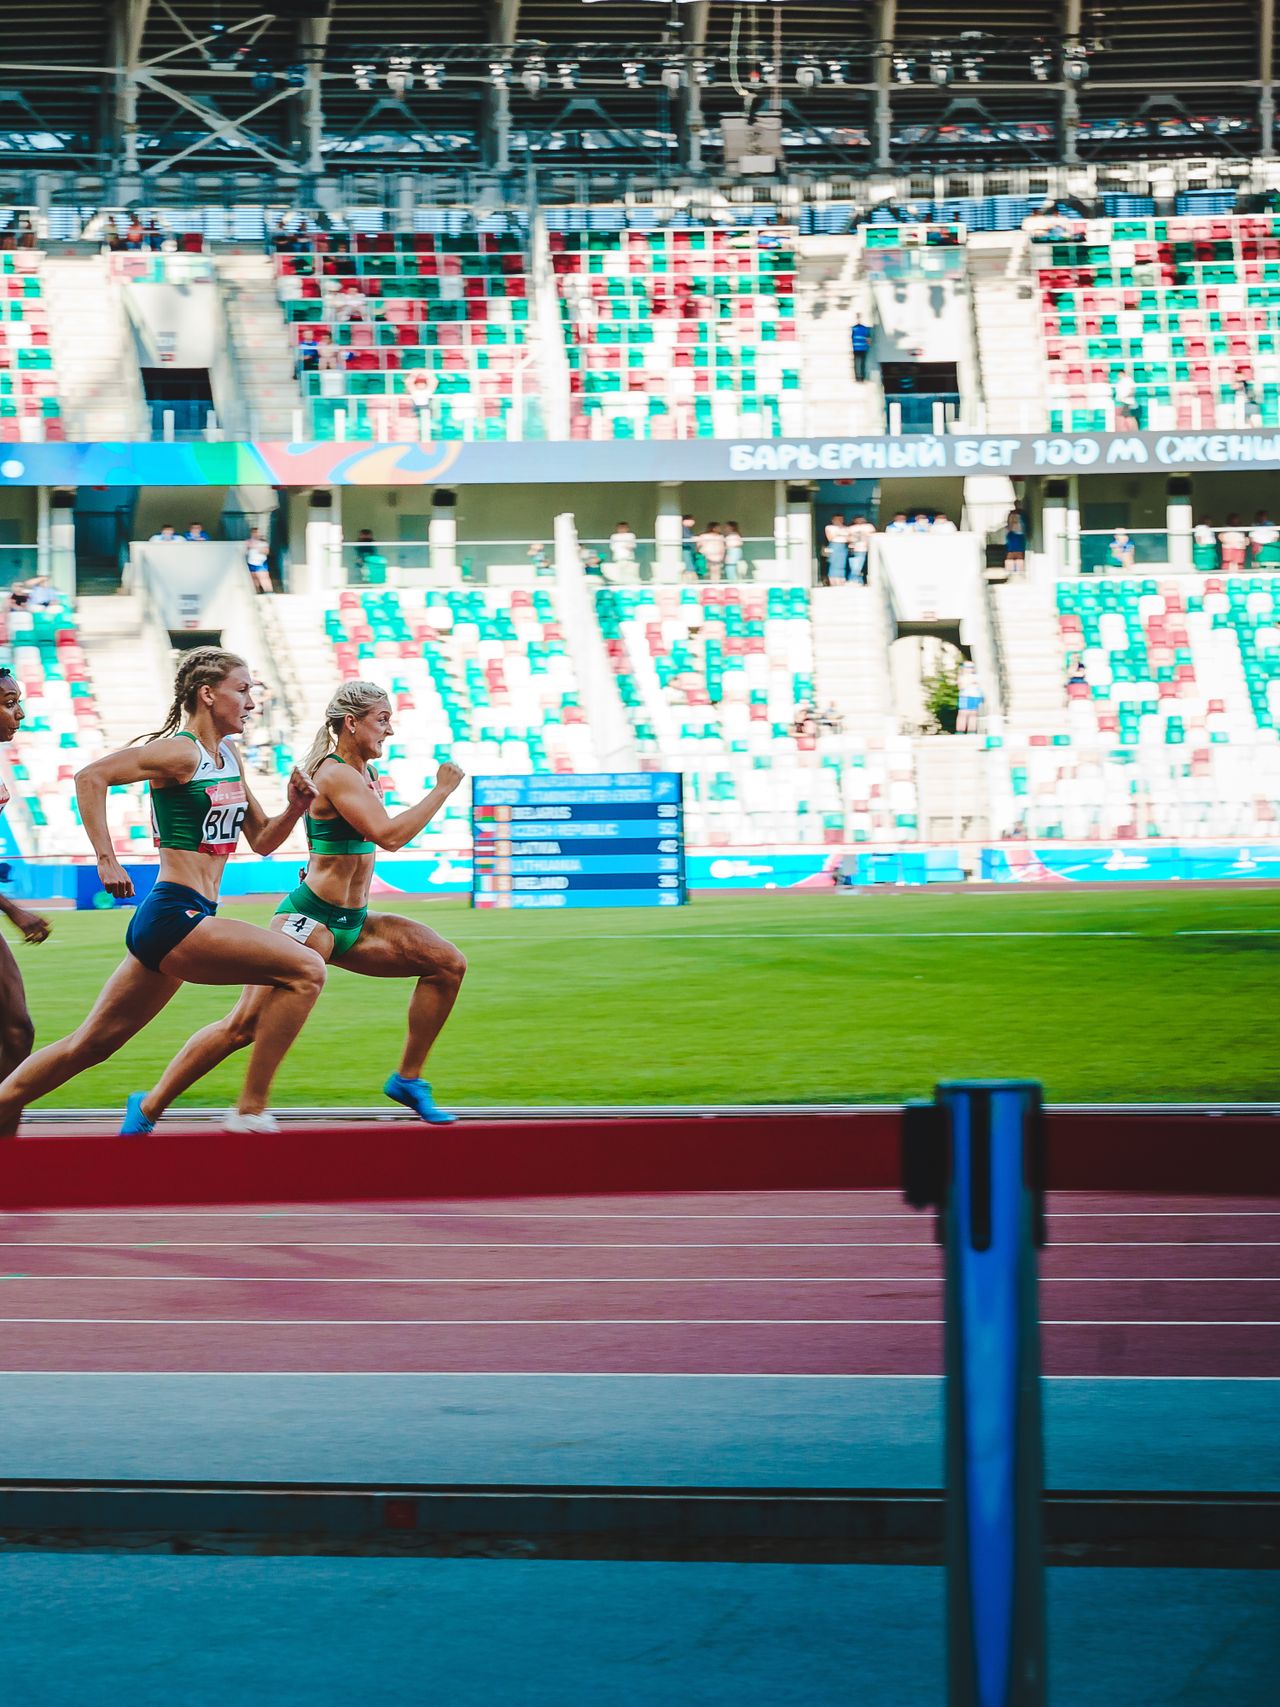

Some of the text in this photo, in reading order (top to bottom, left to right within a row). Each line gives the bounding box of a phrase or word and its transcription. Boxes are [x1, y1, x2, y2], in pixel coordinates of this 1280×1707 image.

[729, 434, 946, 471] БАРЬЕРНЫЙ
[954, 440, 1020, 467] БЕГ
[1031, 438, 1100, 466] 100
[292, 917, 308, 932] 4
